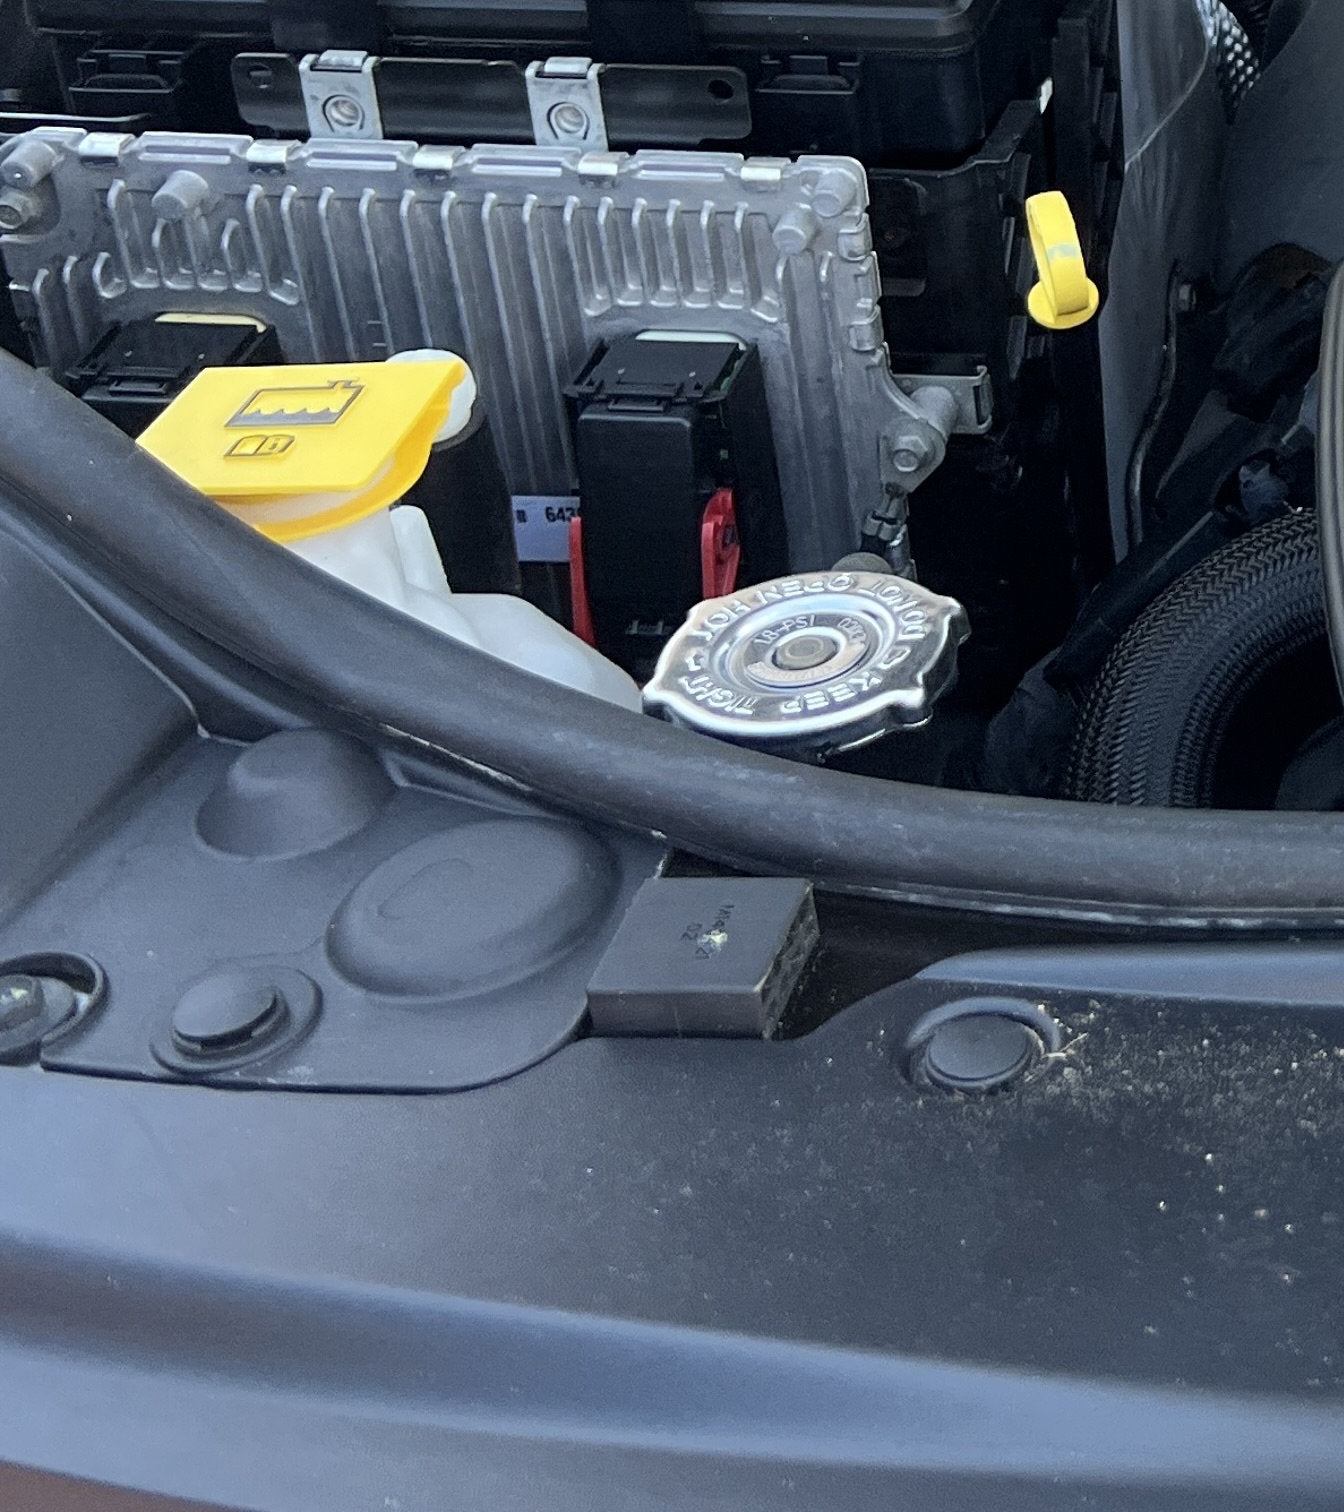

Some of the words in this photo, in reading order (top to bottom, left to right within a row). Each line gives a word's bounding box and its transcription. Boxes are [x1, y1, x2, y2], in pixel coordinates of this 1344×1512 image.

[756, 572, 853, 605] OPEN
[689, 597, 752, 642] HOT
[678, 673, 756, 715] TIGHT
[779, 670, 883, 714] KEEP
